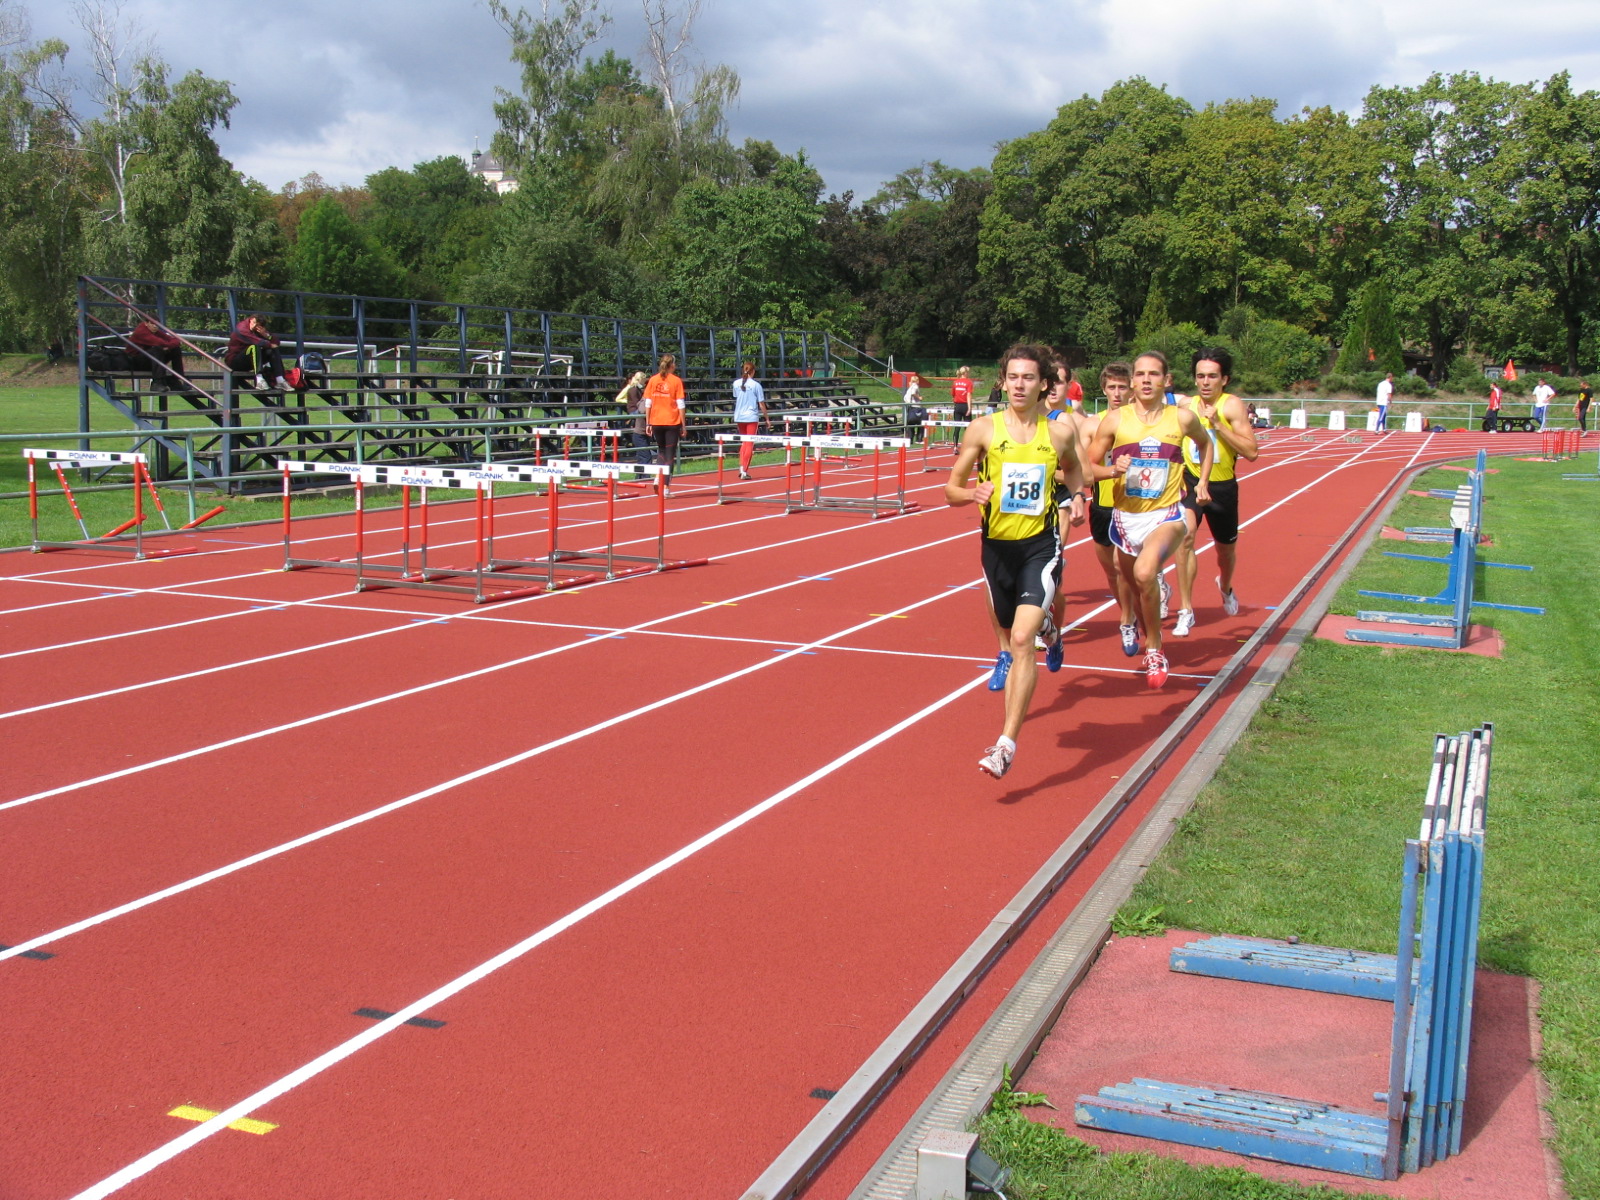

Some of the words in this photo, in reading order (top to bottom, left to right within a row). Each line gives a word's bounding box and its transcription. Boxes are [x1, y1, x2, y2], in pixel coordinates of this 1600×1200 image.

[69, 452, 98, 460] POLANIK
[328, 464, 362, 473] POLANIK
[469, 471, 504, 480] POLANIK
[1139, 467, 1151, 488] 8
[401, 476, 434, 486] POLANIK
[1007, 481, 1041, 501] 158
